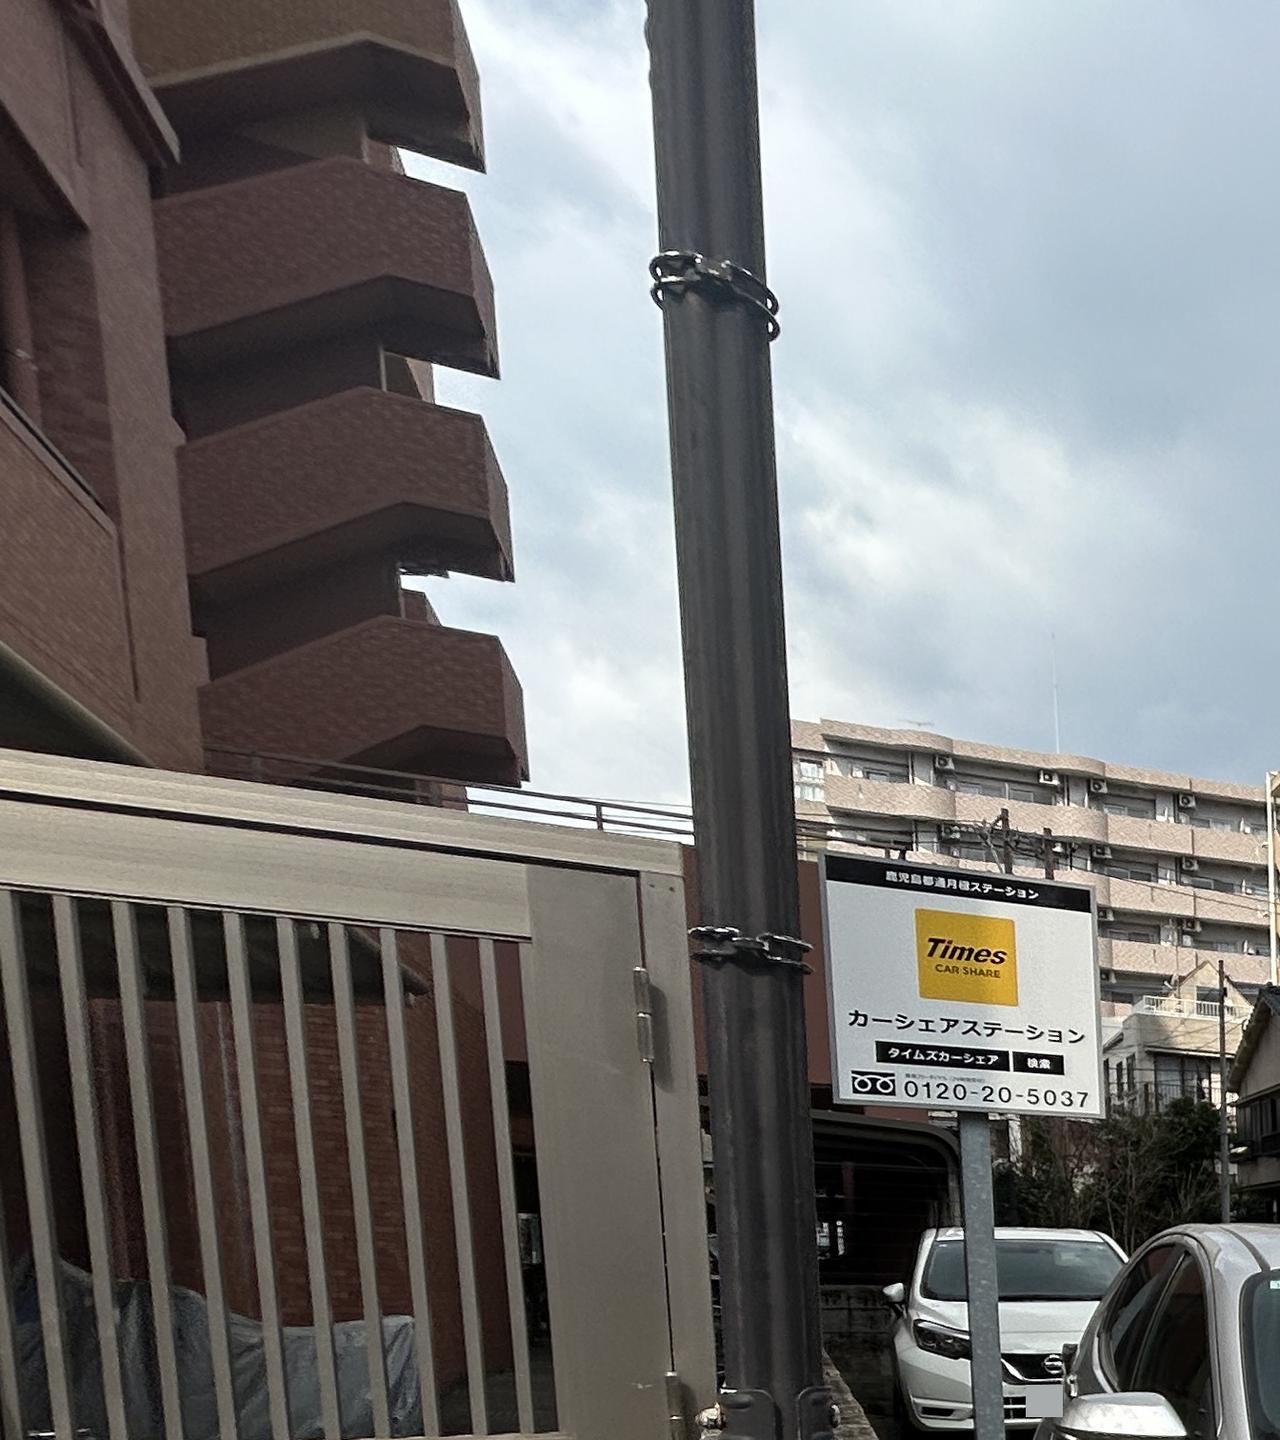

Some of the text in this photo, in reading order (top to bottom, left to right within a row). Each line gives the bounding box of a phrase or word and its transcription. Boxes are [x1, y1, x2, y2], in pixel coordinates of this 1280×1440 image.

[925, 938, 1008, 965] Times
[935, 963, 1001, 979] CAR SHARE
[848, 1010, 1086, 1044] カーシェアステーション
[887, 1047, 1000, 1066] タイムズカーシェア
[1027, 1057, 1052, 1071] 検索
[903, 1079, 1090, 1109] 0120-20-5037
